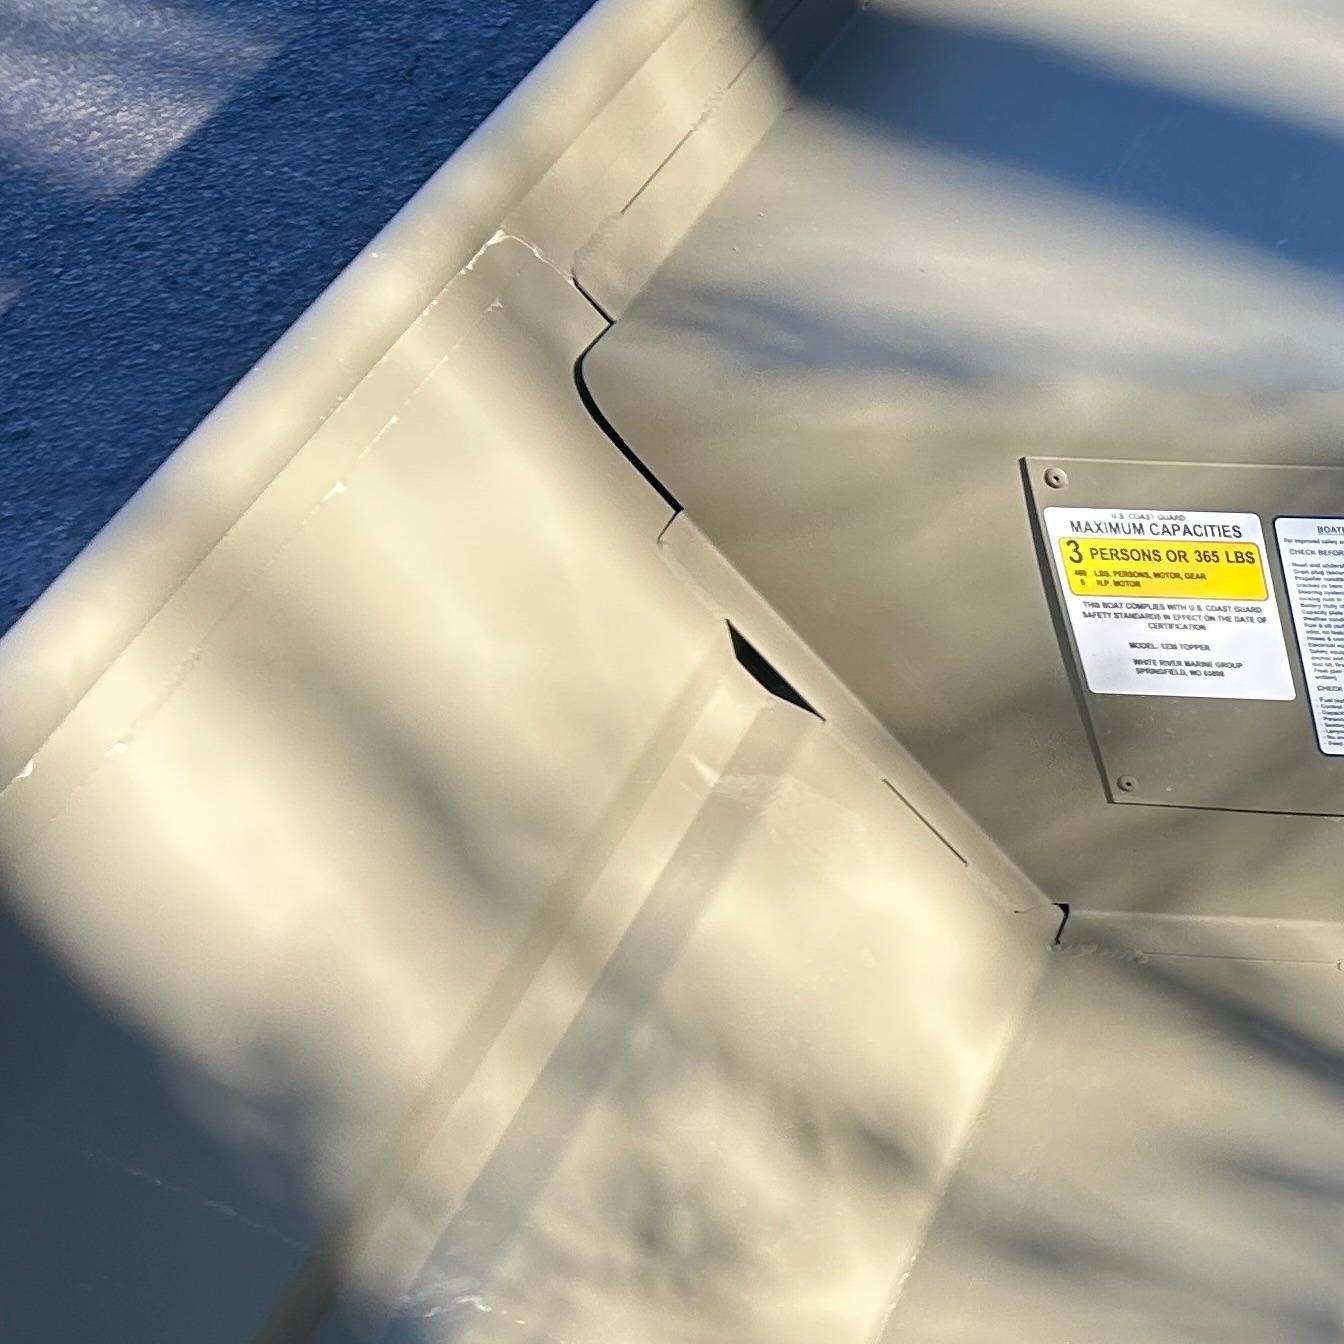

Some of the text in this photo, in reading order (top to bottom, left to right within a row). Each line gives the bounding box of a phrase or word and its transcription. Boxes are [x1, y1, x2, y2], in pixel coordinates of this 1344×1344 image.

[1069, 520, 1242, 538] MAXIMUM CAPACITIES
[1066, 540, 1256, 564] 3 PERSONS OR 365 LBS
[1148, 623, 1207, 631] CERTIFICATION
